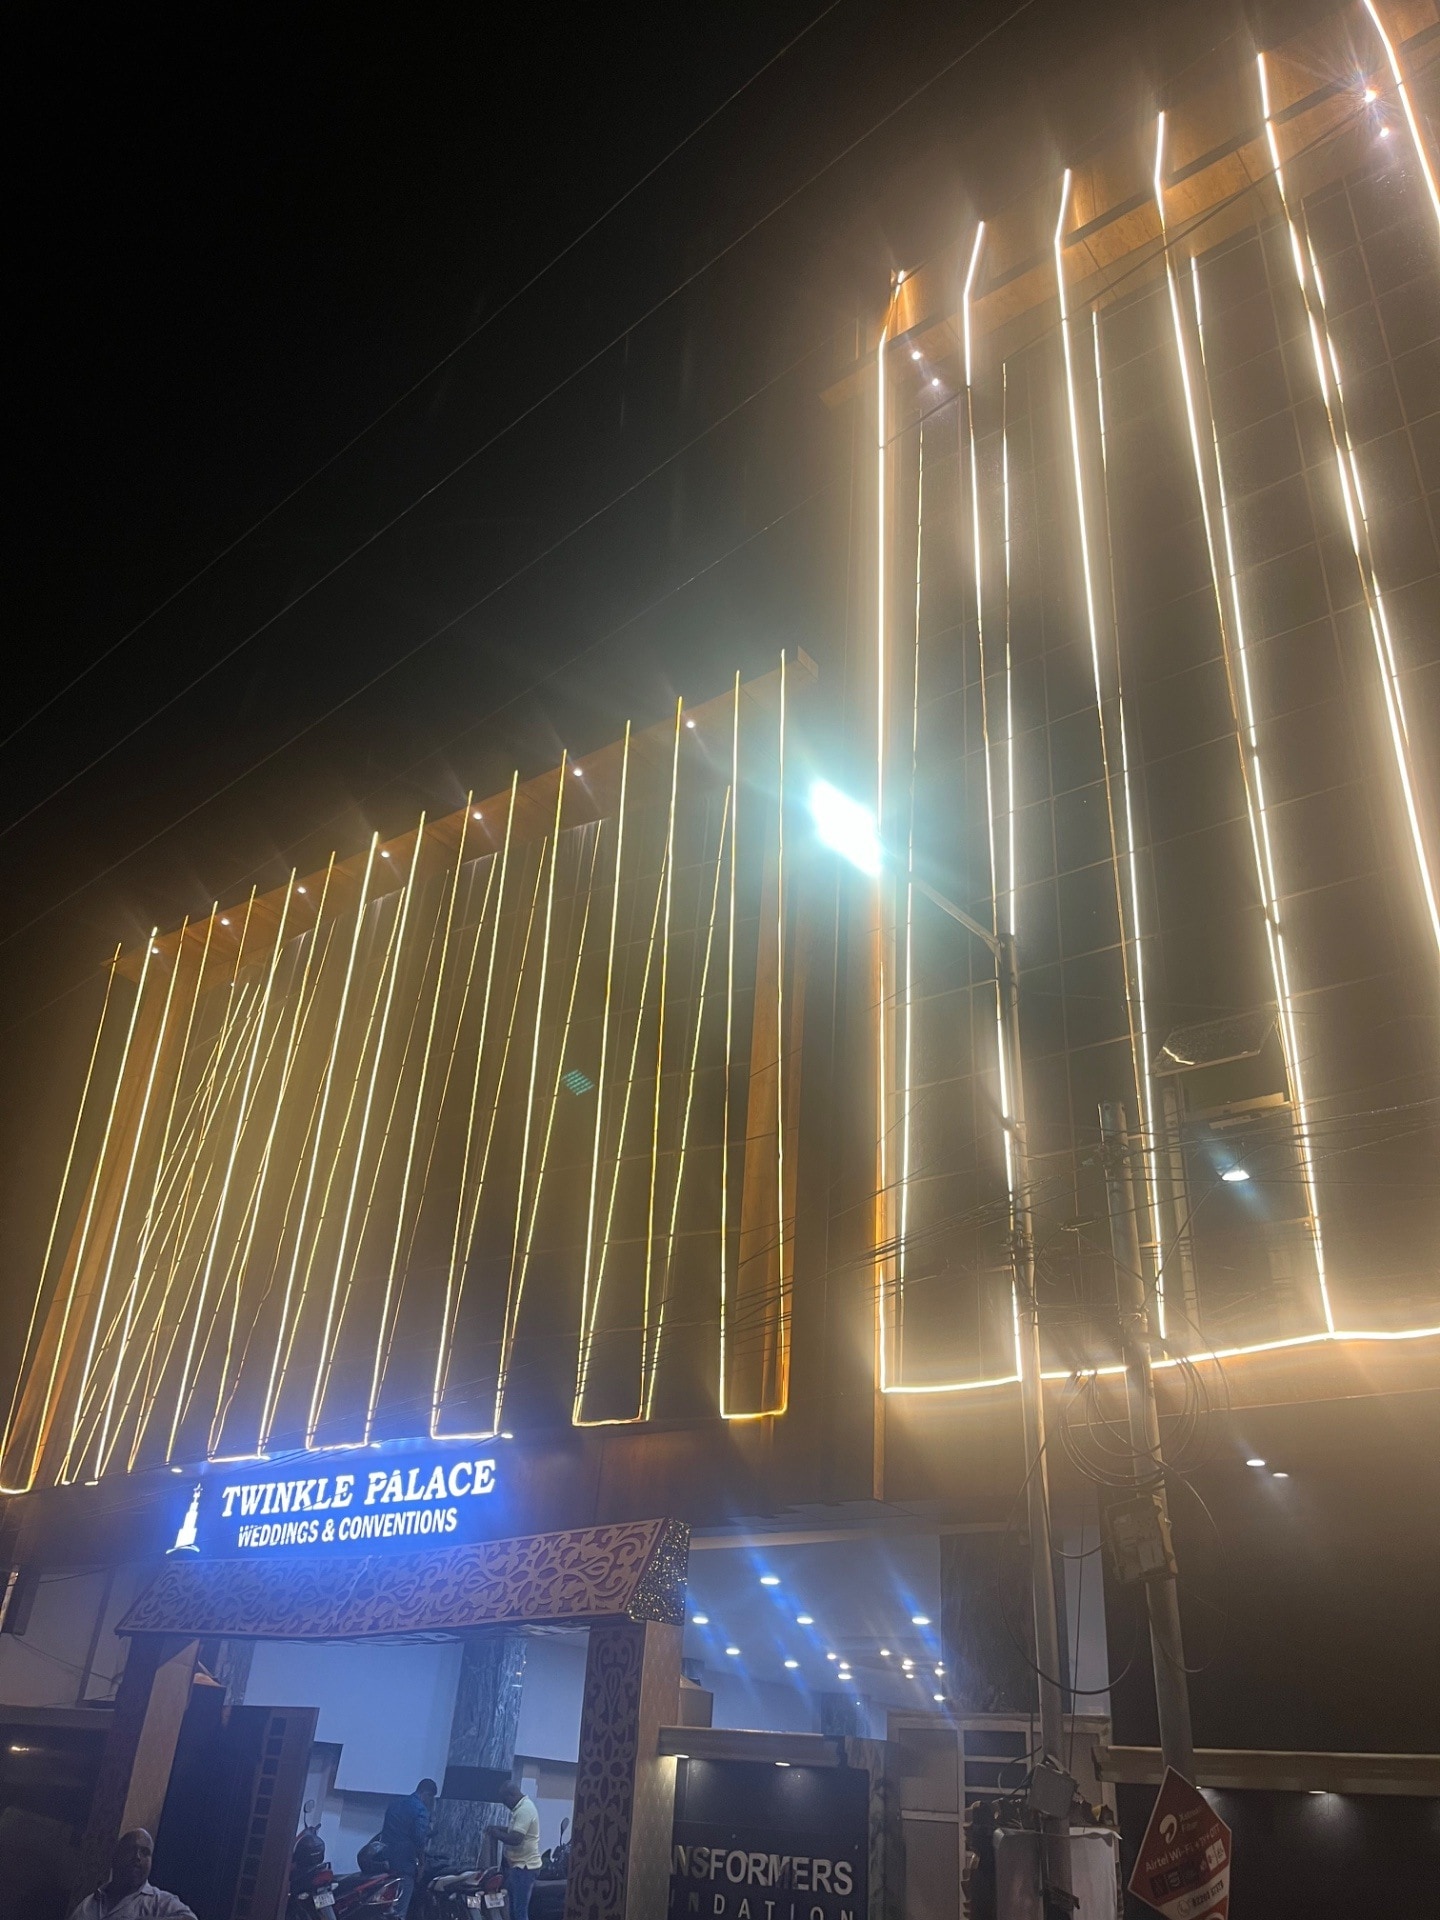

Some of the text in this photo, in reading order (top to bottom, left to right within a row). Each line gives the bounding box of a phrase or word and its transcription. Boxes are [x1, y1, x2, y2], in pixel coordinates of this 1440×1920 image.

[221, 1459, 496, 1517] TWINKLE PALACE
[238, 1507, 457, 1547] WEDDINGS & CONVENTIONS
[671, 1845, 853, 1896] NSFORMERS
[671, 1888, 853, 1920] NDATIO
